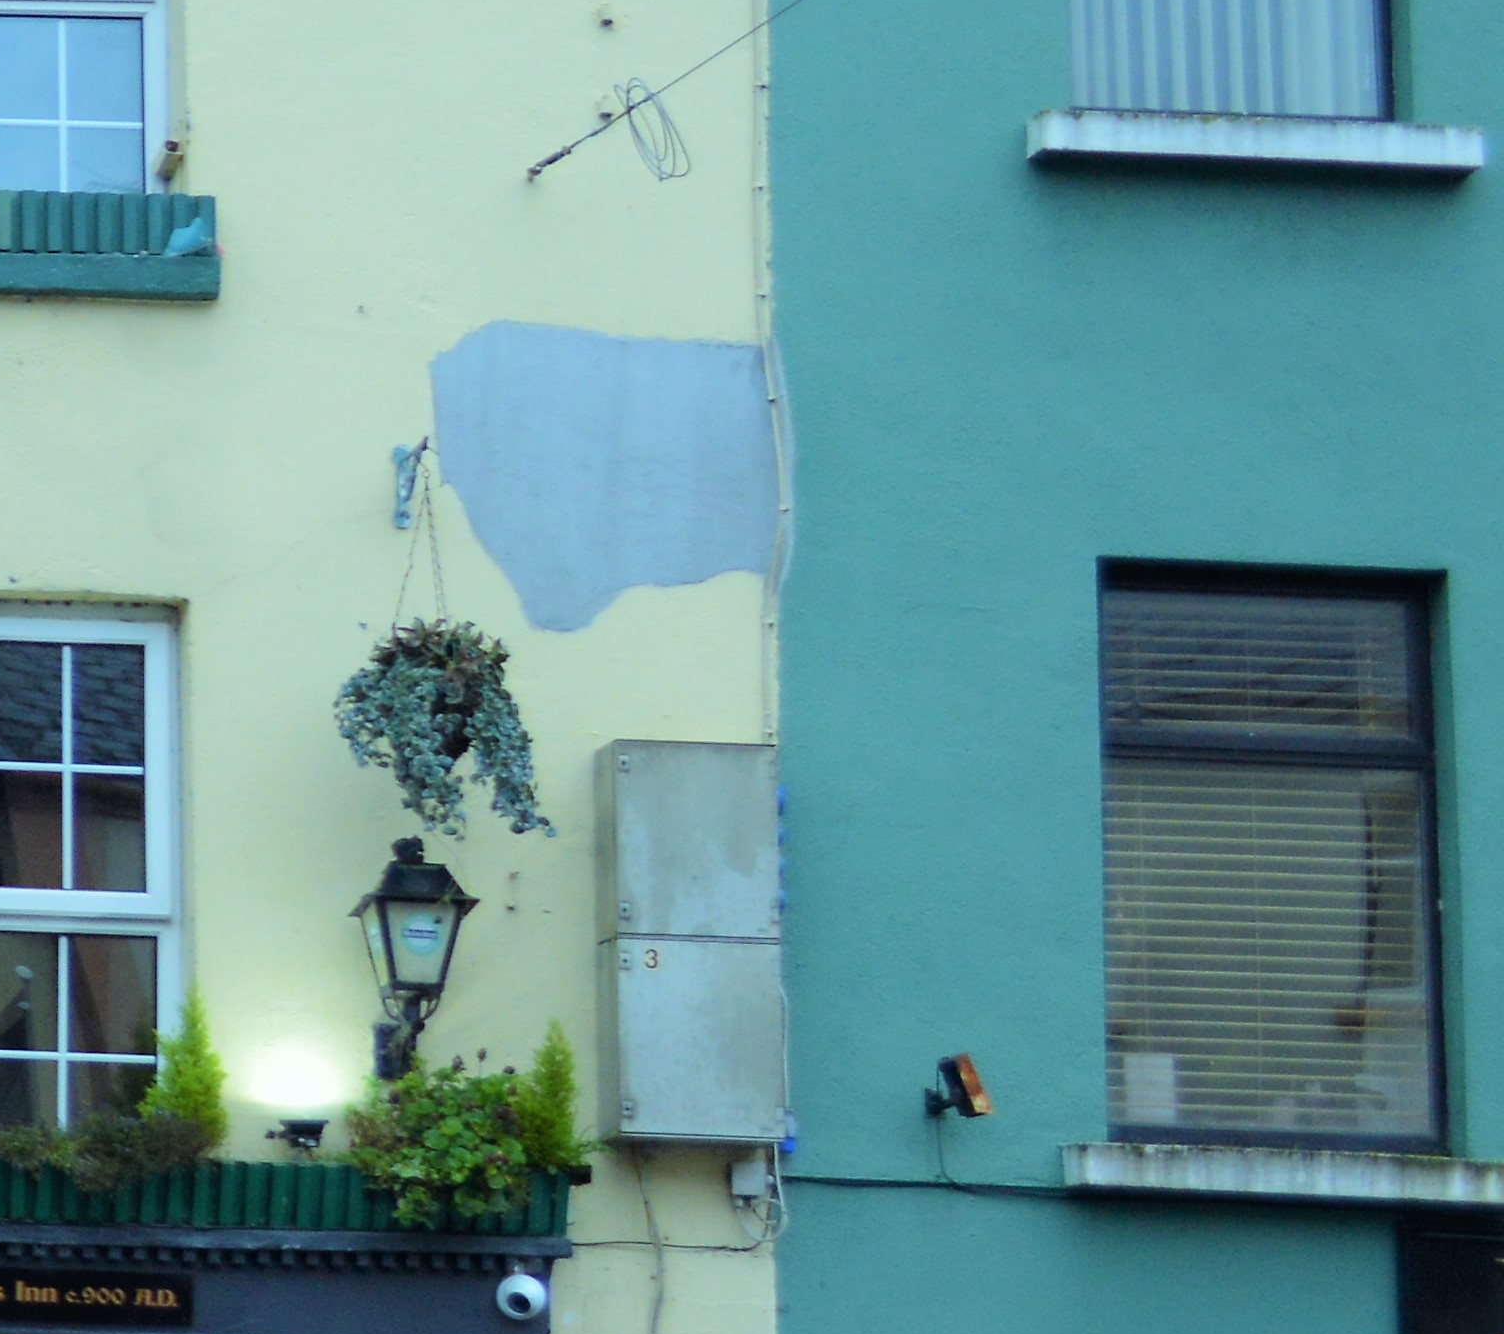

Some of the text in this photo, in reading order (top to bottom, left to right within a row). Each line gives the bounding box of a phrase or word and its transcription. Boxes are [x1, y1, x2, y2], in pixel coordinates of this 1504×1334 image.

[644, 948, 658, 969] 3
[15, 1280, 59, 1304] Inn
[64, 1285, 126, 1306] c.900
